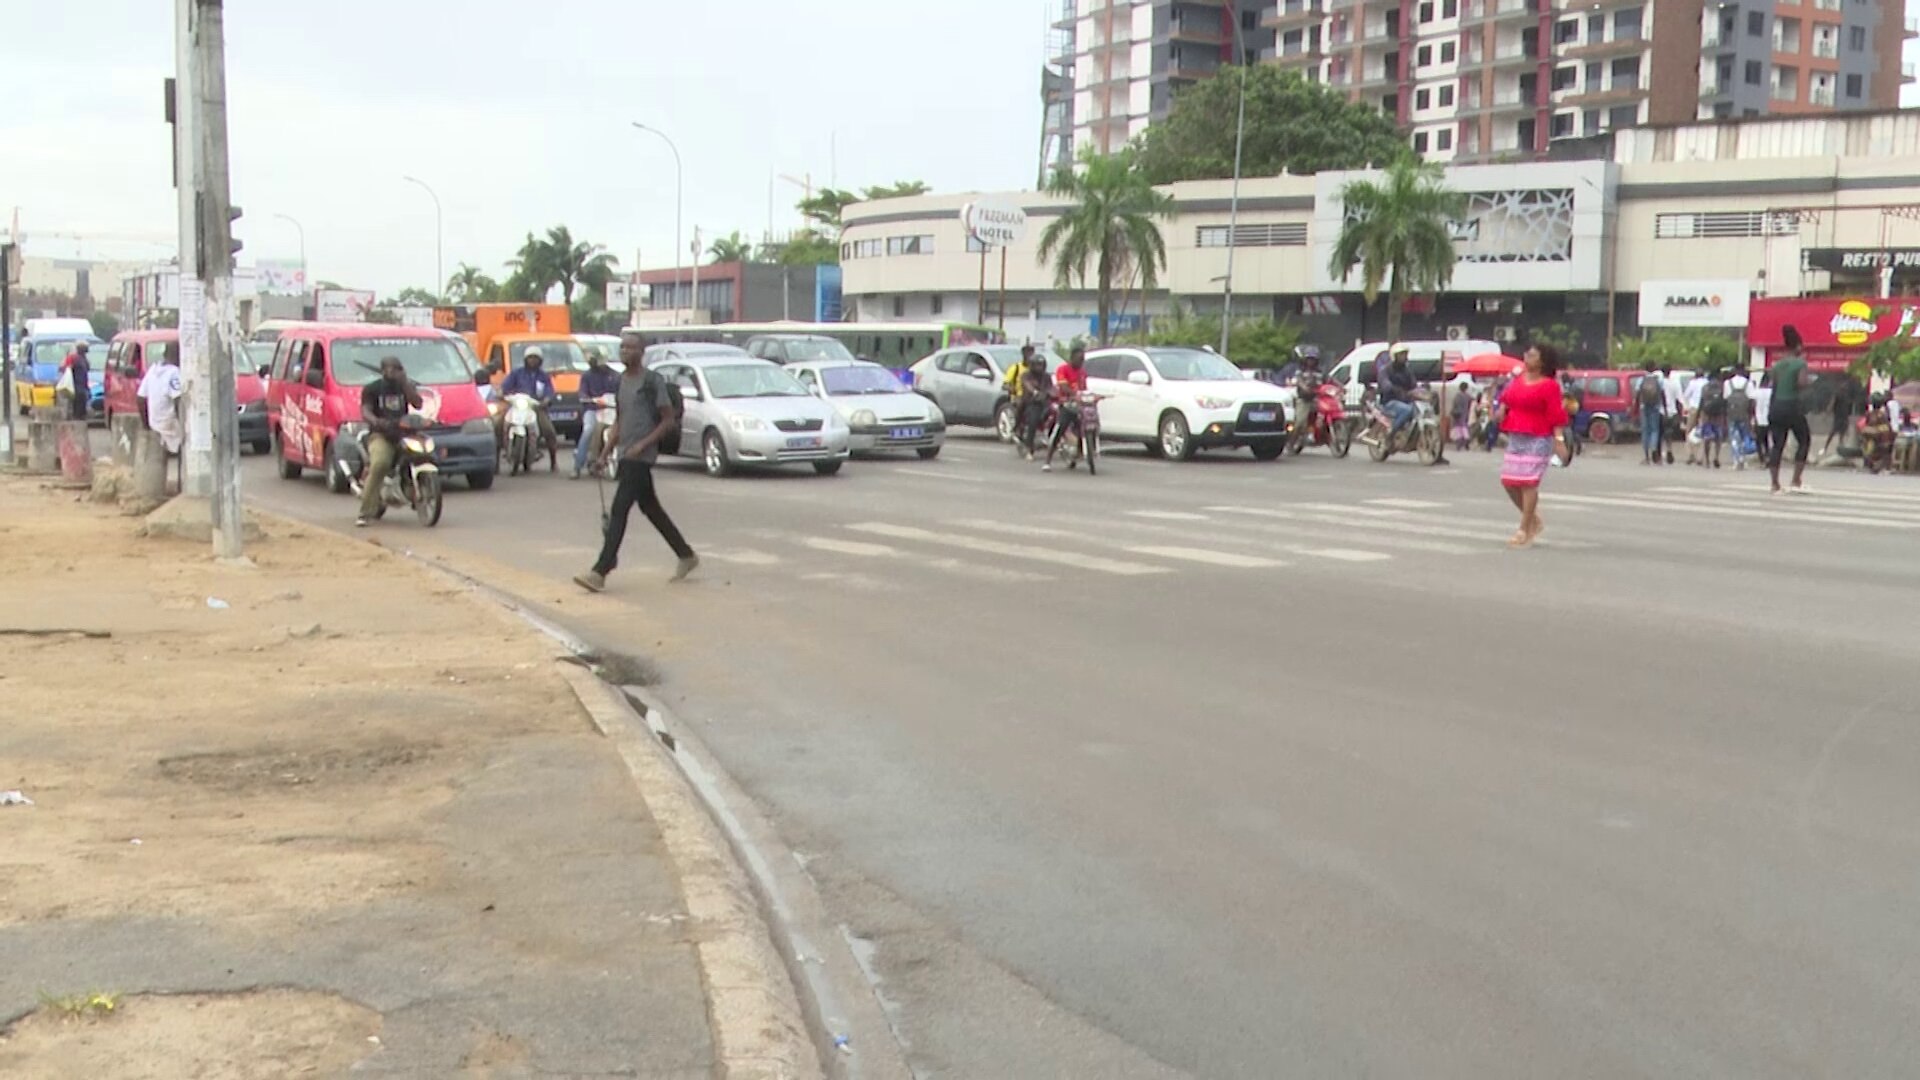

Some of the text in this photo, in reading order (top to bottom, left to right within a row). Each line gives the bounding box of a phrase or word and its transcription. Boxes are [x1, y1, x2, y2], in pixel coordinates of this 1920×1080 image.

[980, 227, 1014, 240] HOTEL
[1842, 252, 1890, 267] RESTO
[1664, 296, 1709, 307] JUMIA
